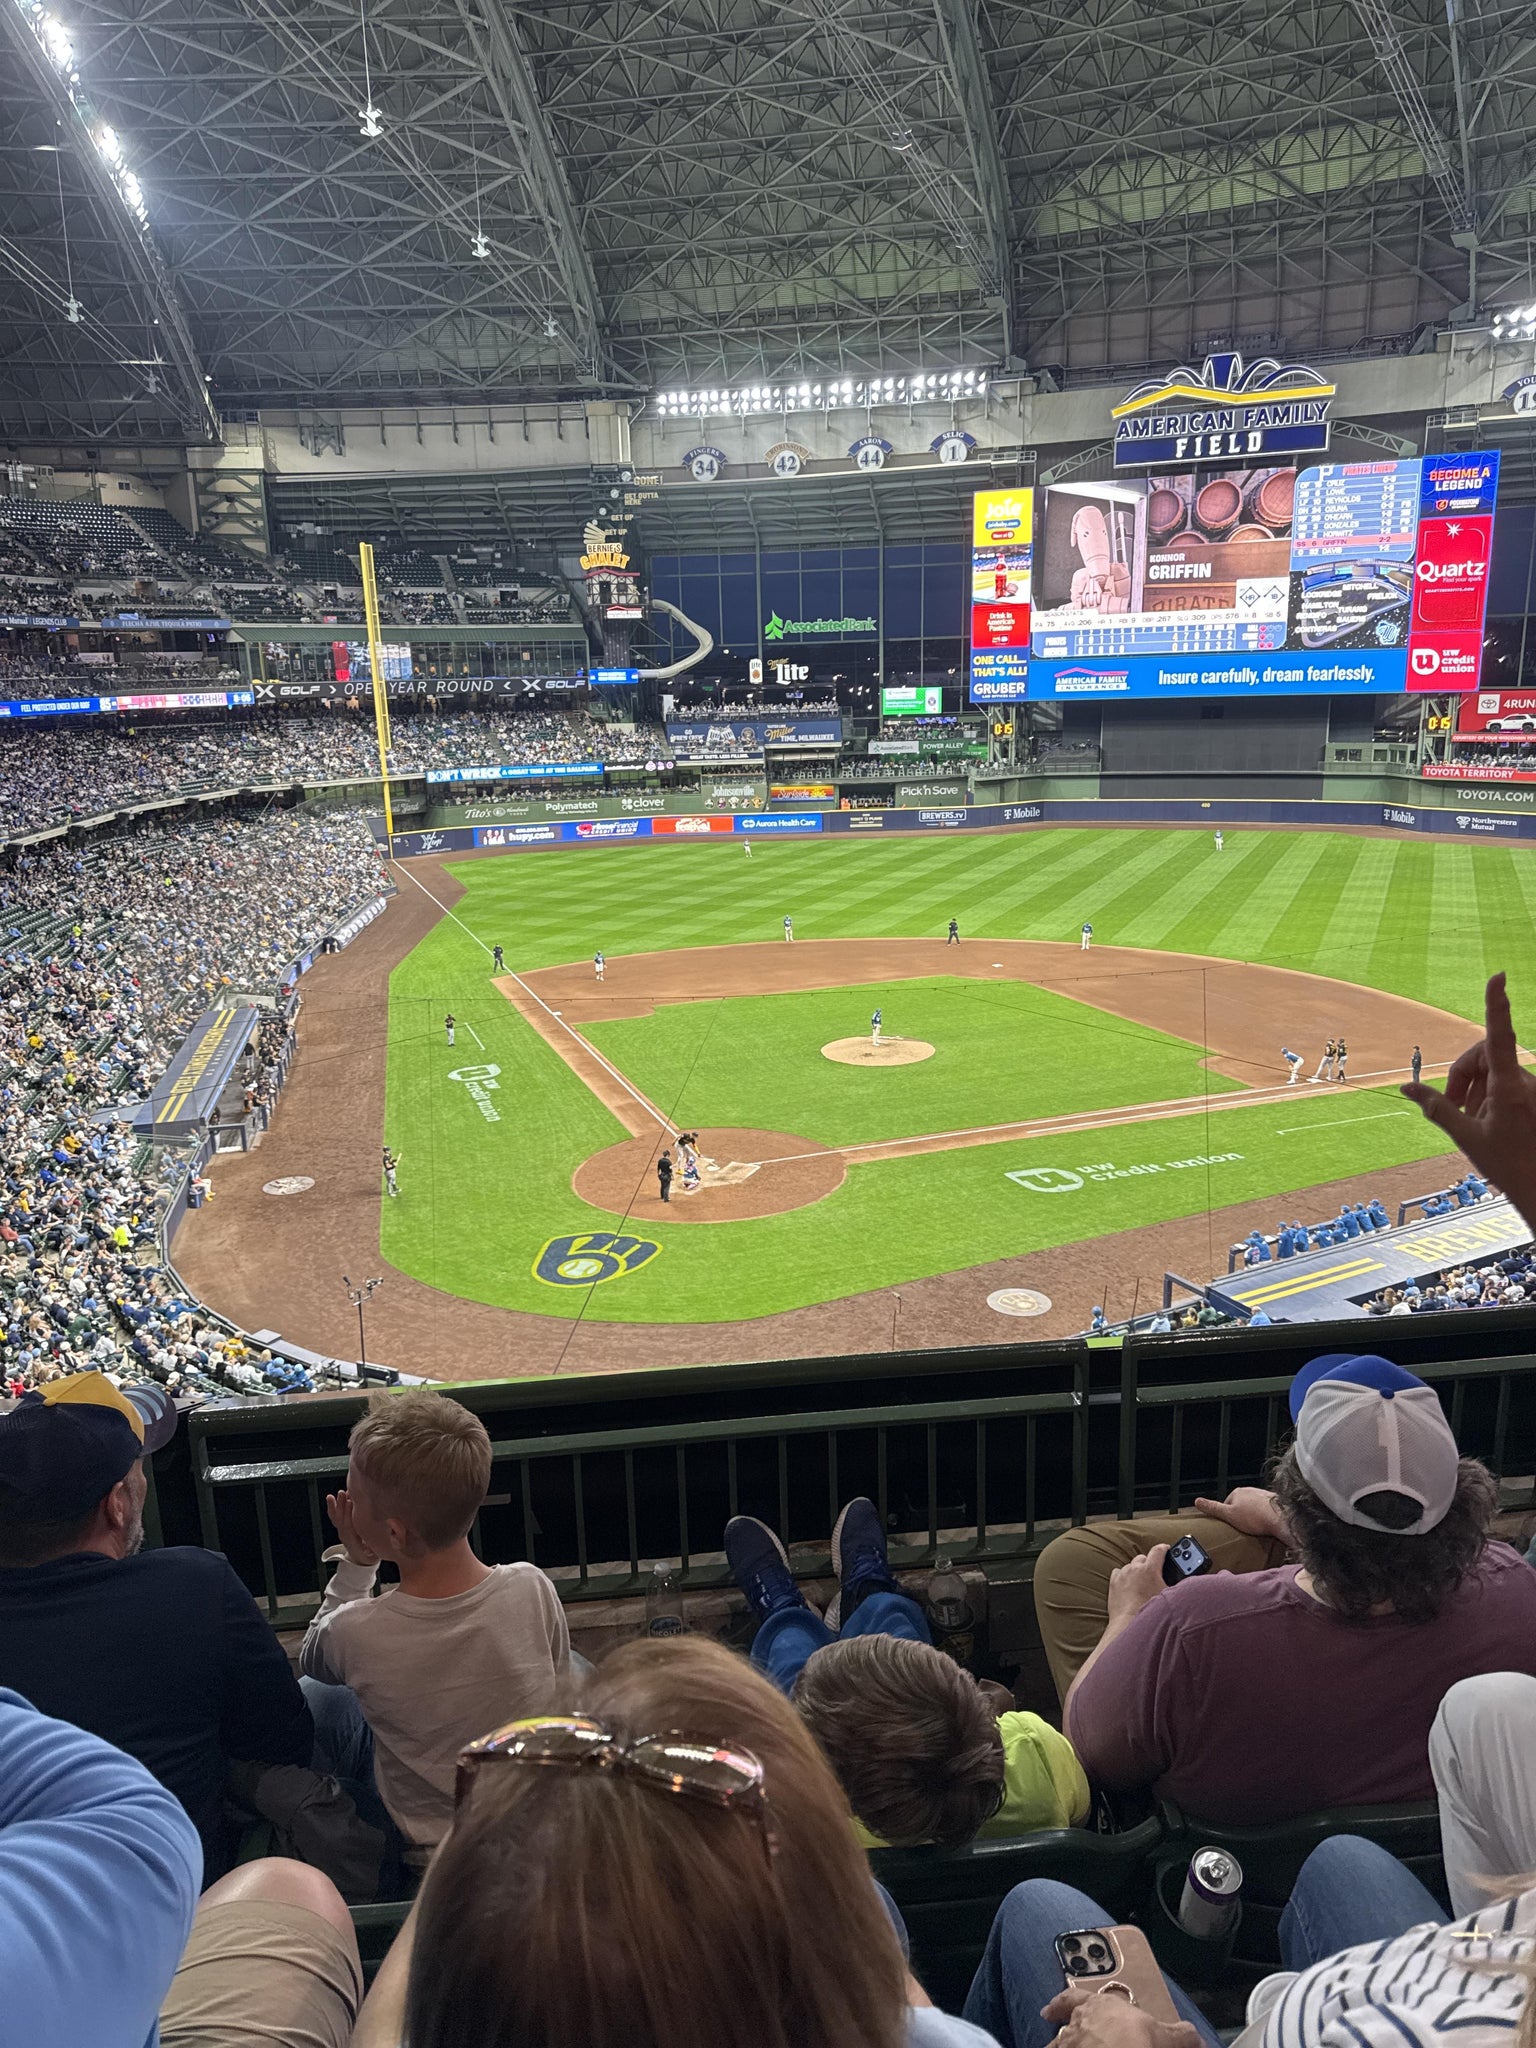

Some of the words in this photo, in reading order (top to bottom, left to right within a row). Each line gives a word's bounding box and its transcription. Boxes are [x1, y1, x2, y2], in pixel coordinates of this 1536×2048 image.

[1116, 411, 1235, 440] AMERICAN
[1244, 401, 1331, 428] FAMILY
[943, 431, 964, 440] SELIG
[858, 438, 882, 447] AARON
[1175, 431, 1262, 459] FIELD
[689, 448, 719, 458] FINGERS
[860, 450, 881, 467] 44
[949, 445, 958, 461] 1
[695, 459, 715, 476] 34
[776, 455, 797, 472] 42
[1429, 467, 1479, 481] BECOME
[1481, 466, 1490, 478] A
[633, 475, 663, 486] GONE!
[1435, 478, 1483, 491] LEGEND
[618, 528, 628, 536] UP
[588, 543, 621, 553] BERNIE'S
[579, 552, 631, 570] CHALET
[1149, 553, 1185, 563] KONNOR
[1149, 562, 1212, 580] GRIFFIN
[1416, 560, 1486, 583] Quartz
[32, 618, 54, 626] LEGENDS
[54, 618, 67, 626] CLUB
[973, 656, 994, 665] ONE
[1441, 655, 1475, 664] credit
[776, 663, 809, 685] Lite
[973, 667, 1005, 677] THAT'S
[1007, 666, 1028, 676] ALL!
[1441, 664, 1475, 673] union
[1056, 676, 1096, 685] AMERICAN
[1098, 675, 1128, 683] FAMILY
[1158, 669, 1198, 685] Insure
[1201, 667, 1259, 686] carefully,
[1262, 666, 1304, 683] dream
[1307, 664, 1376, 684] fearlessly.
[280, 685, 321, 696] GOLF
[389, 681, 427, 694] YEAR
[436, 680, 495, 693] ROUND
[545, 679, 586, 690] GOLF
[973, 682, 1025, 695] GRUBER
[1503, 699, 1536, 709] 4RUN
[764, 726, 796, 742] Miller
[798, 733, 835, 742] MILWAUKEE
[460, 768, 501, 780] WRECK
[1425, 767, 1460, 777] TOYOTA
[1463, 768, 1514, 778] TERRITORY
[711, 786, 755, 798] Johnsonville
[901, 786, 923, 796] Pick
[932, 786, 959, 795] Save
[1456, 789, 1534, 803] TOYOTA.COM
[545, 801, 598, 811] Polymatech
[633, 798, 665, 807] clover
[465, 808, 491, 819] Tito's
[1012, 807, 1041, 819] Mobile
[1390, 810, 1415, 824] Mobile
[755, 820, 779, 828] Aurora
[779, 819, 800, 827] Health
[800, 819, 817, 827] Care
[1471, 816, 1518, 826] Northwestern
[1471, 823, 1495, 831] Mutual
[508, 831, 555, 843] hupy.com
[465, 1081, 491, 1101] credit
[476, 1099, 501, 1122] union
[1075, 1162, 1116, 1173] uw
[1090, 1163, 1166, 1181] credit
[1166, 1152, 1245, 1169] union
[1392, 1211, 1530, 1263] BREWE
